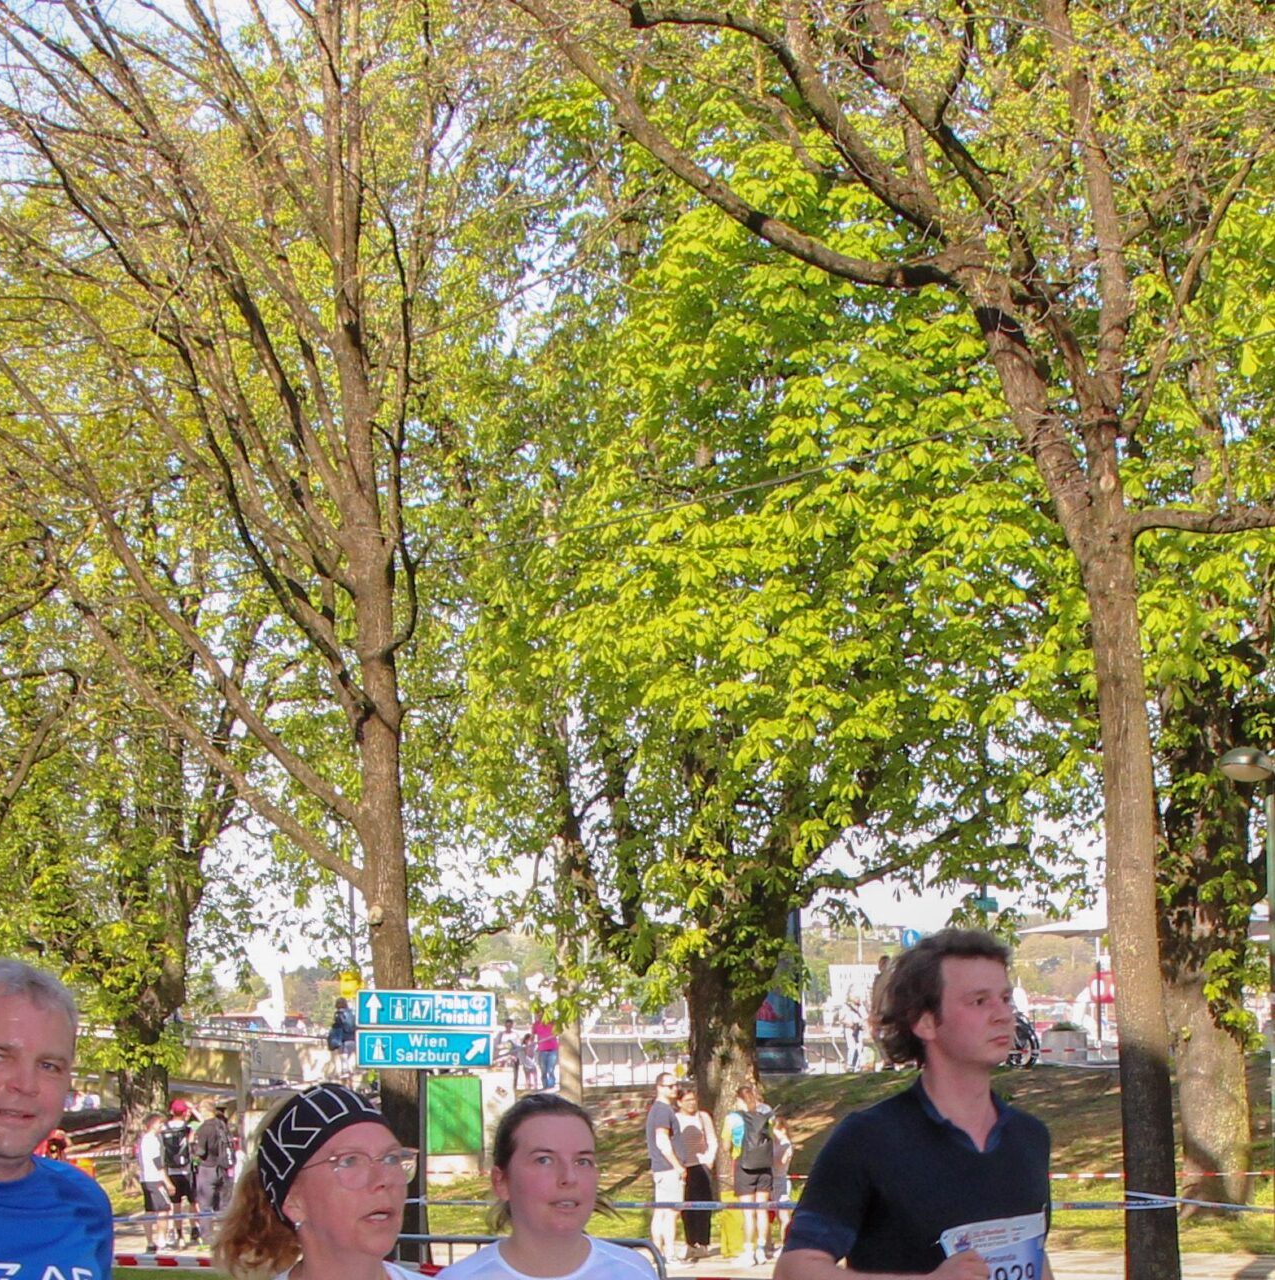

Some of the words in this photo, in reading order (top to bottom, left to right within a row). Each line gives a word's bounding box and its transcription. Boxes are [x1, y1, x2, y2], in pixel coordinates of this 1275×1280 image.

[411, 999, 430, 1019] A7
[434, 995, 469, 1009] Praha
[434, 1009, 488, 1024] Freistadt
[408, 1034, 448, 1048] Wien
[395, 1048, 461, 1066] Salzburg
